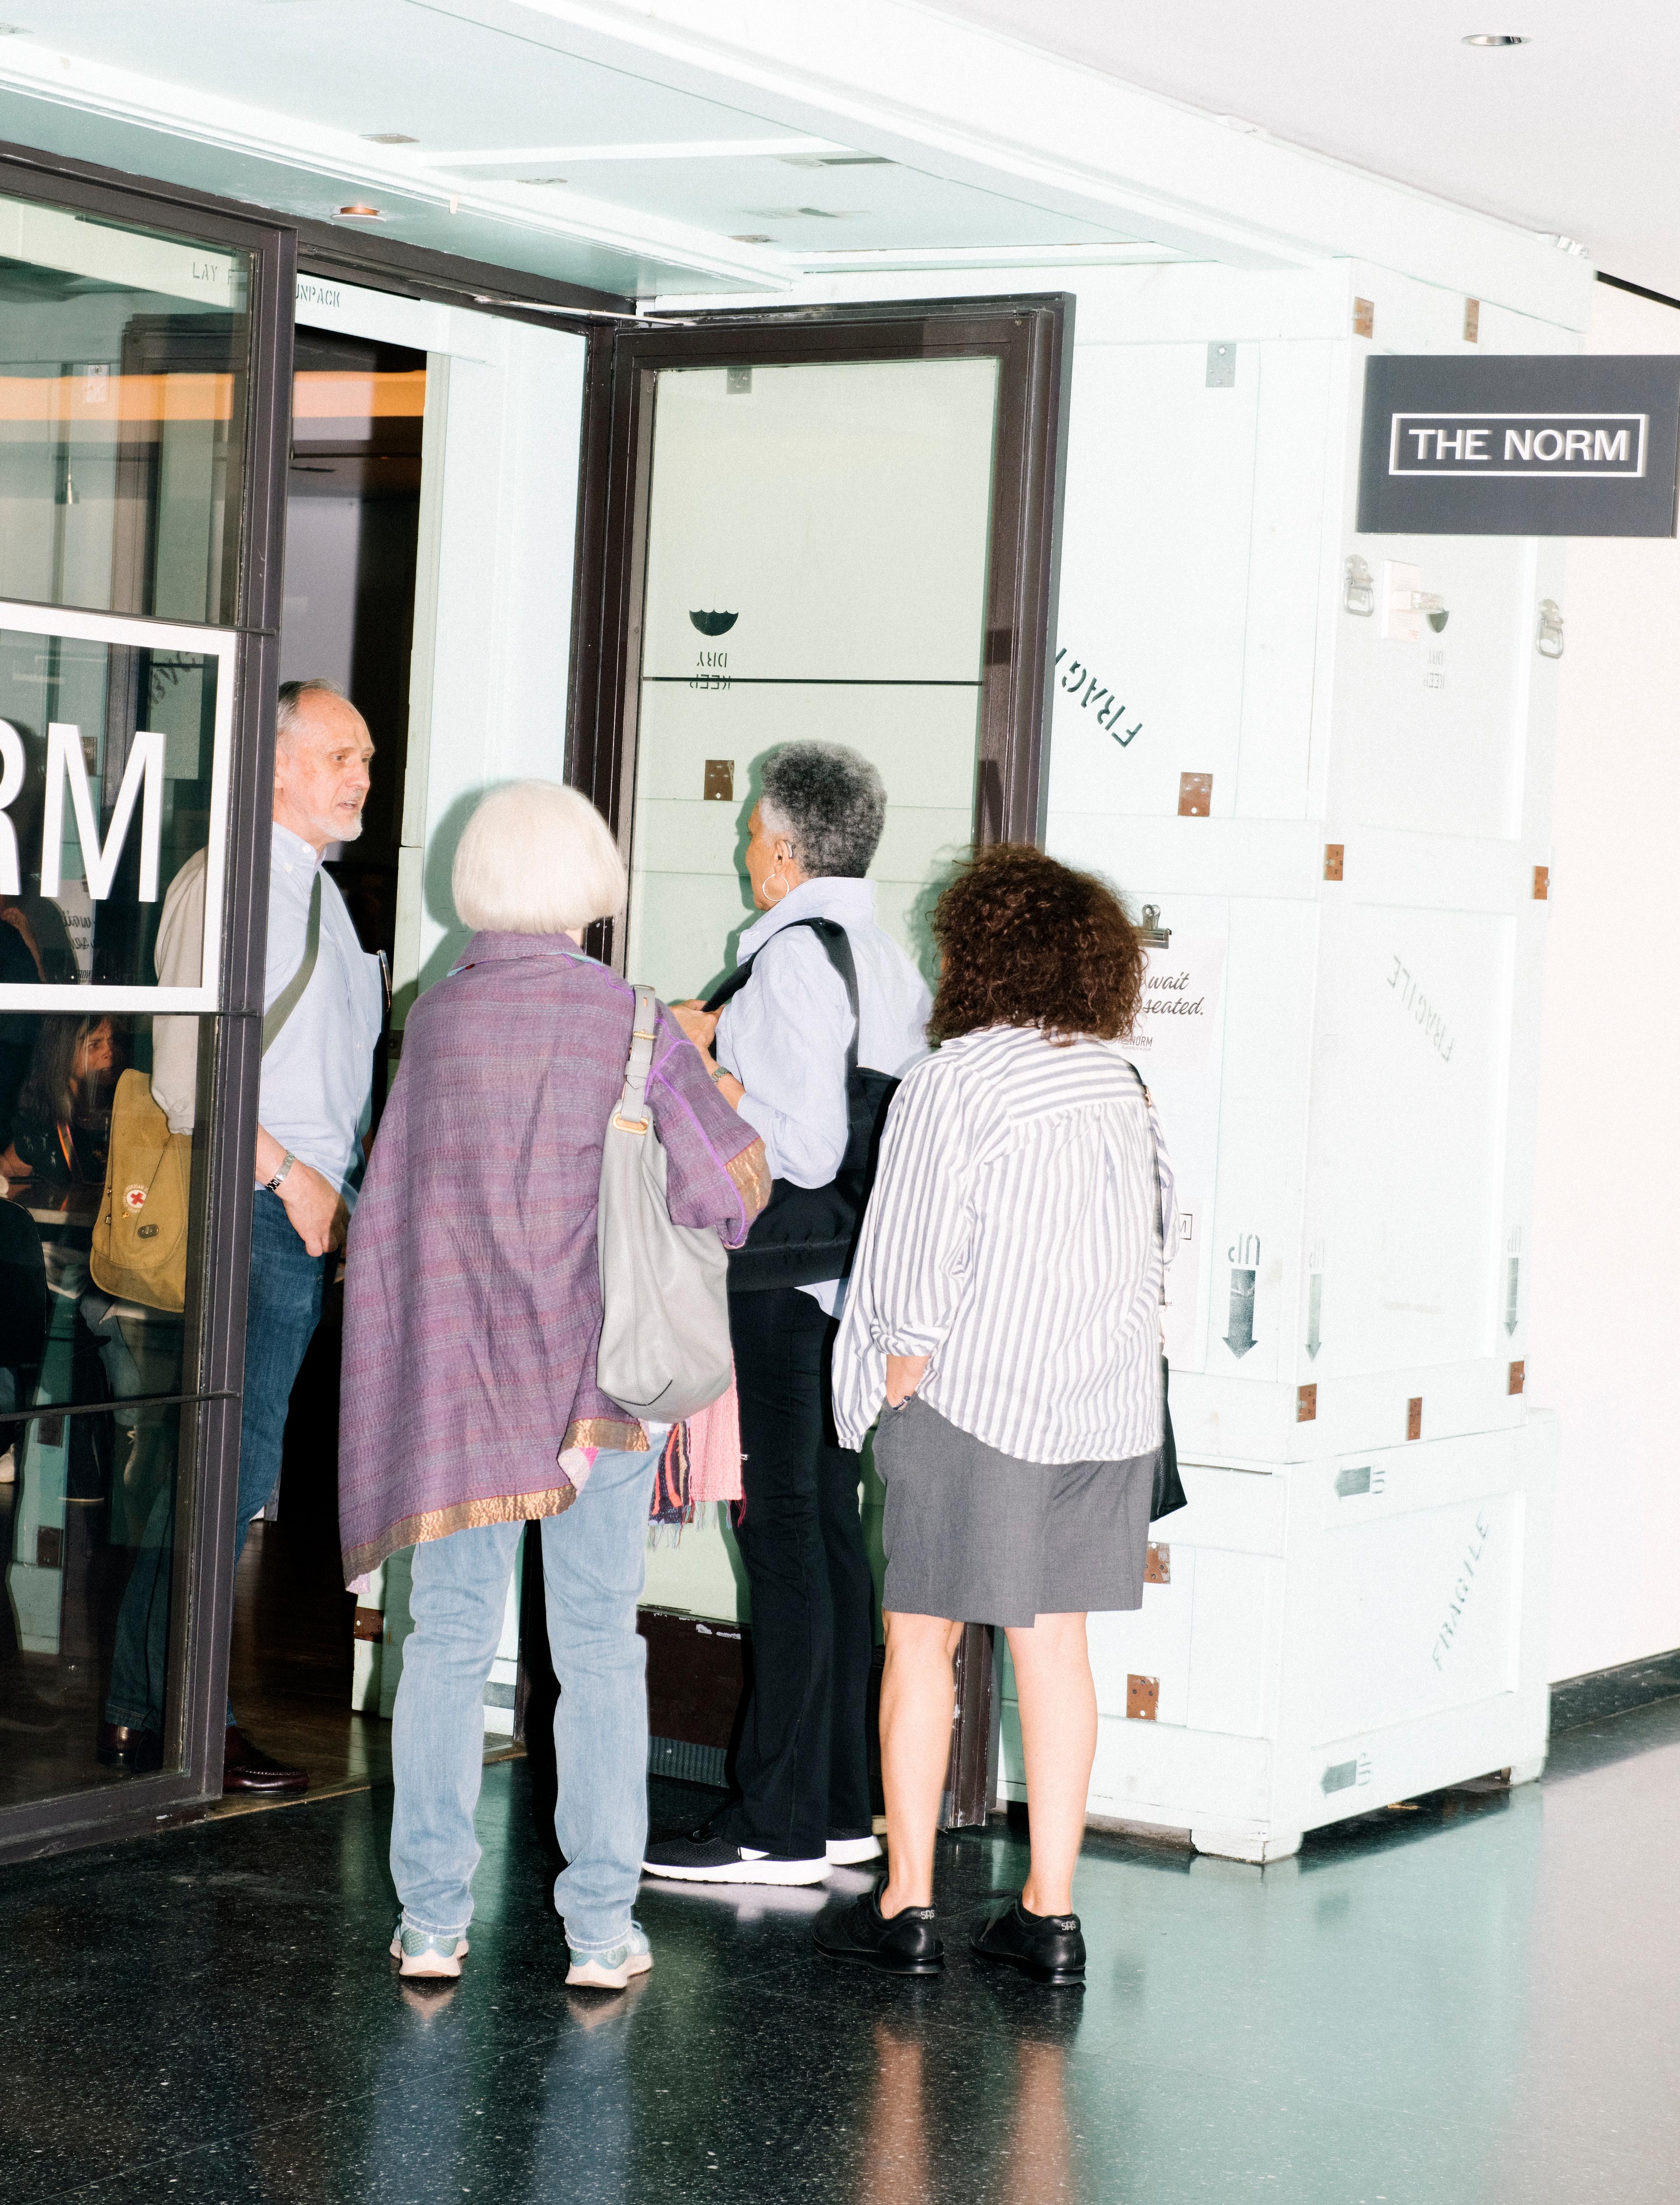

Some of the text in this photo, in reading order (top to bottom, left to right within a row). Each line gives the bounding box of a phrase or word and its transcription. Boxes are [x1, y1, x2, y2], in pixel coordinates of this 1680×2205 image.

[192, 262, 218, 282] LAY
[1409, 429, 1628, 461] THE NORM
[696, 651, 727, 668] DRY
[690, 674, 731, 691] KEEP
[1148, 971, 1190, 990] wait
[1143, 996, 1204, 1016] seated.
[1386, 954, 1455, 1062] FRAGILE
[1228, 1233, 1260, 1266] UP
[1432, 1510, 1488, 1671] FRAGILE
[920, 1909, 934, 1920] SAS
[1061, 1920, 1076, 1931] SAS
